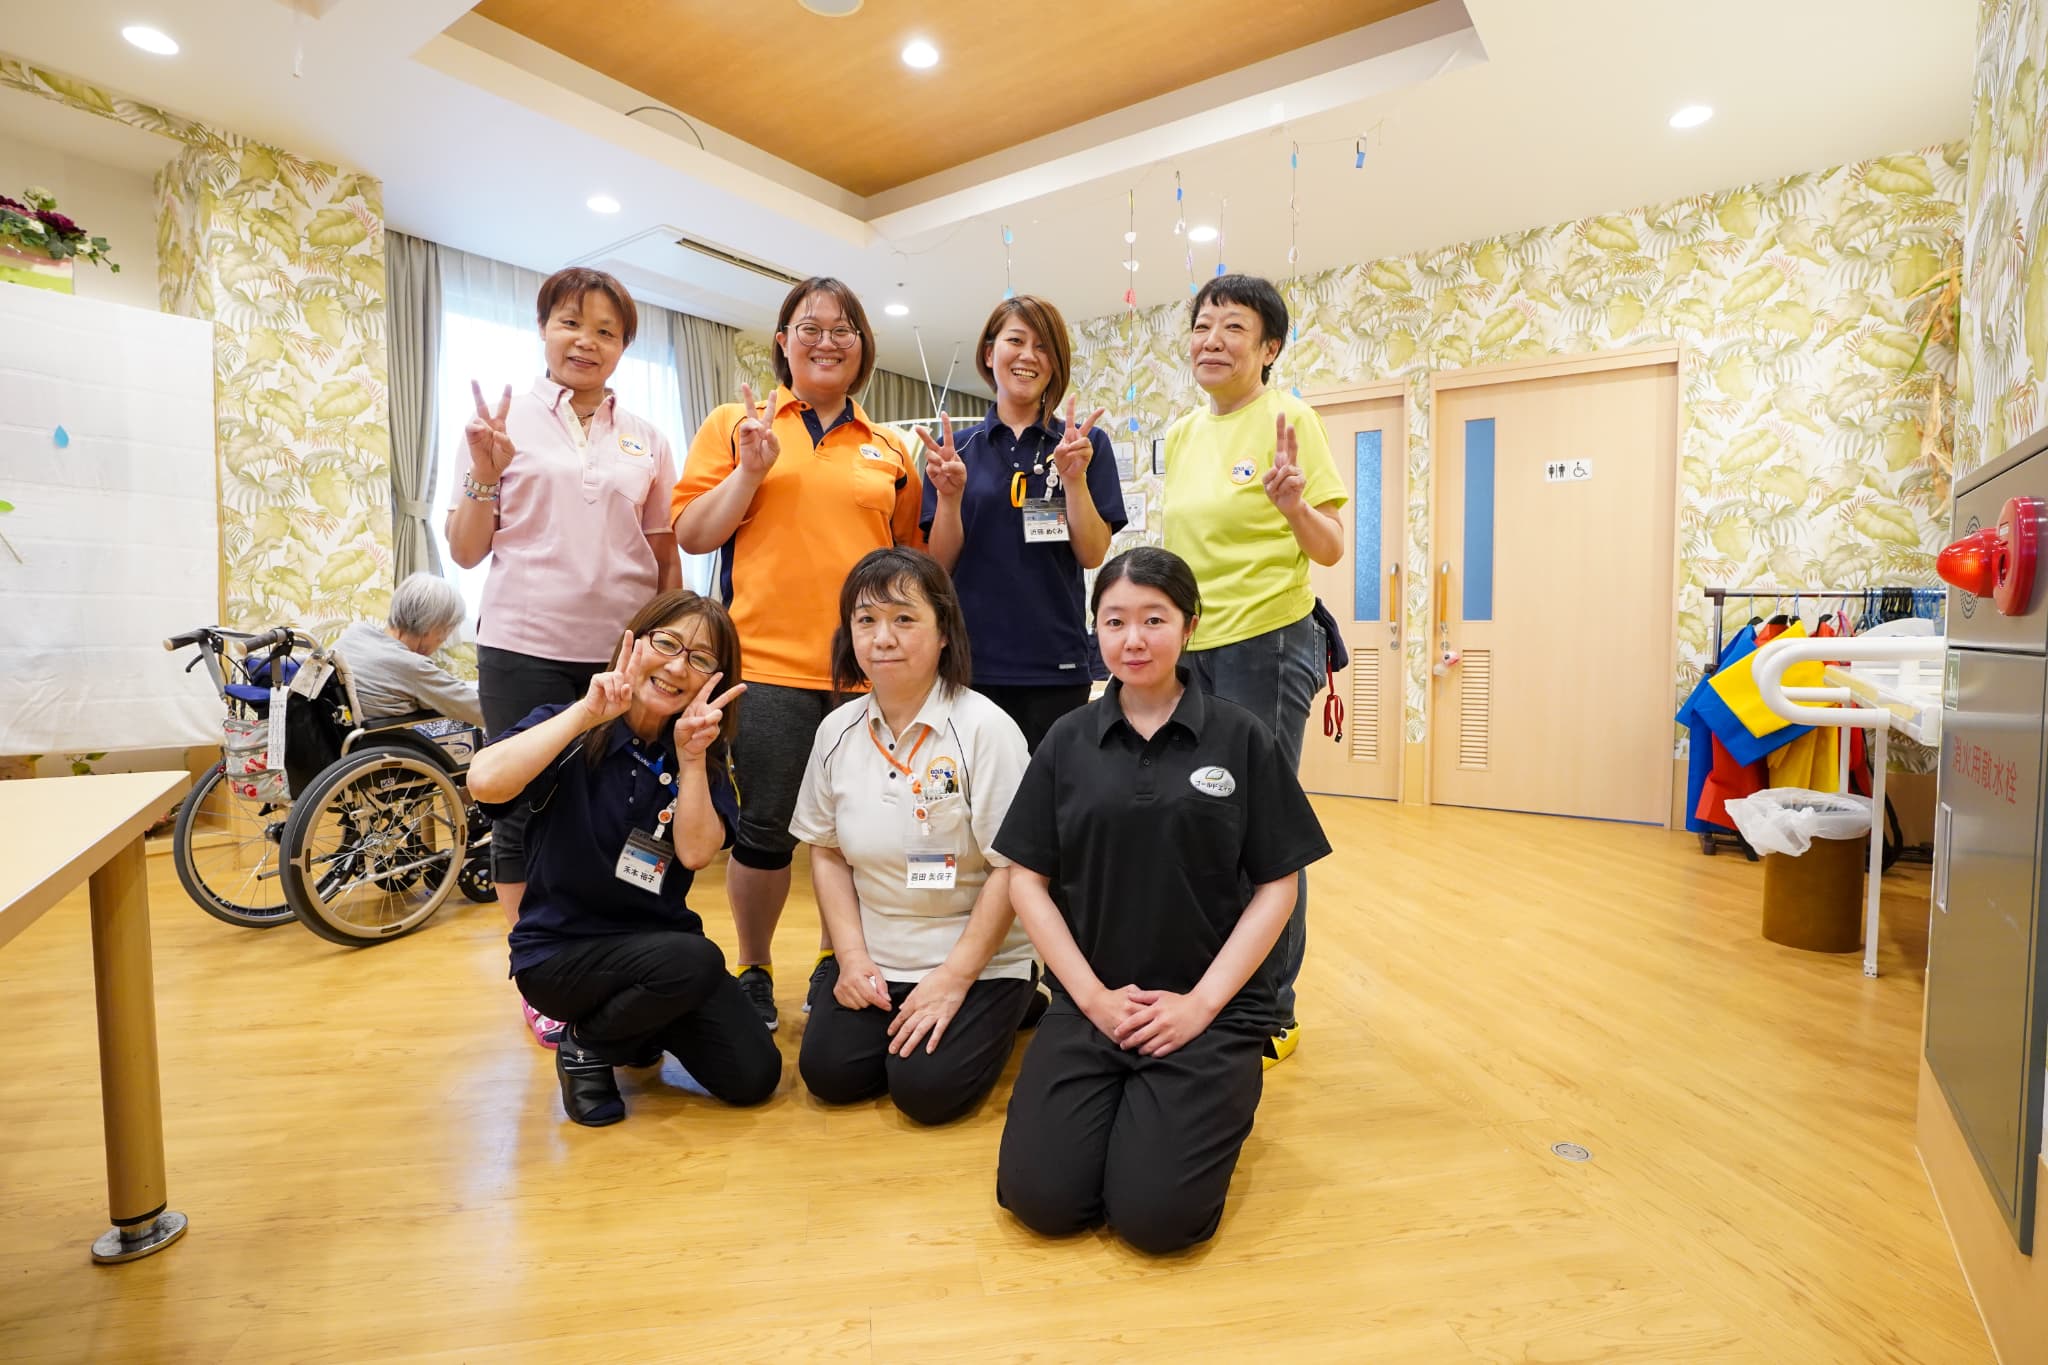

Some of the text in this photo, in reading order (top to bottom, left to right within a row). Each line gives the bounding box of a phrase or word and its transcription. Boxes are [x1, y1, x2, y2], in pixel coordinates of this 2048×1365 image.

[1953, 735, 2017, 805] 消火用散水栓
